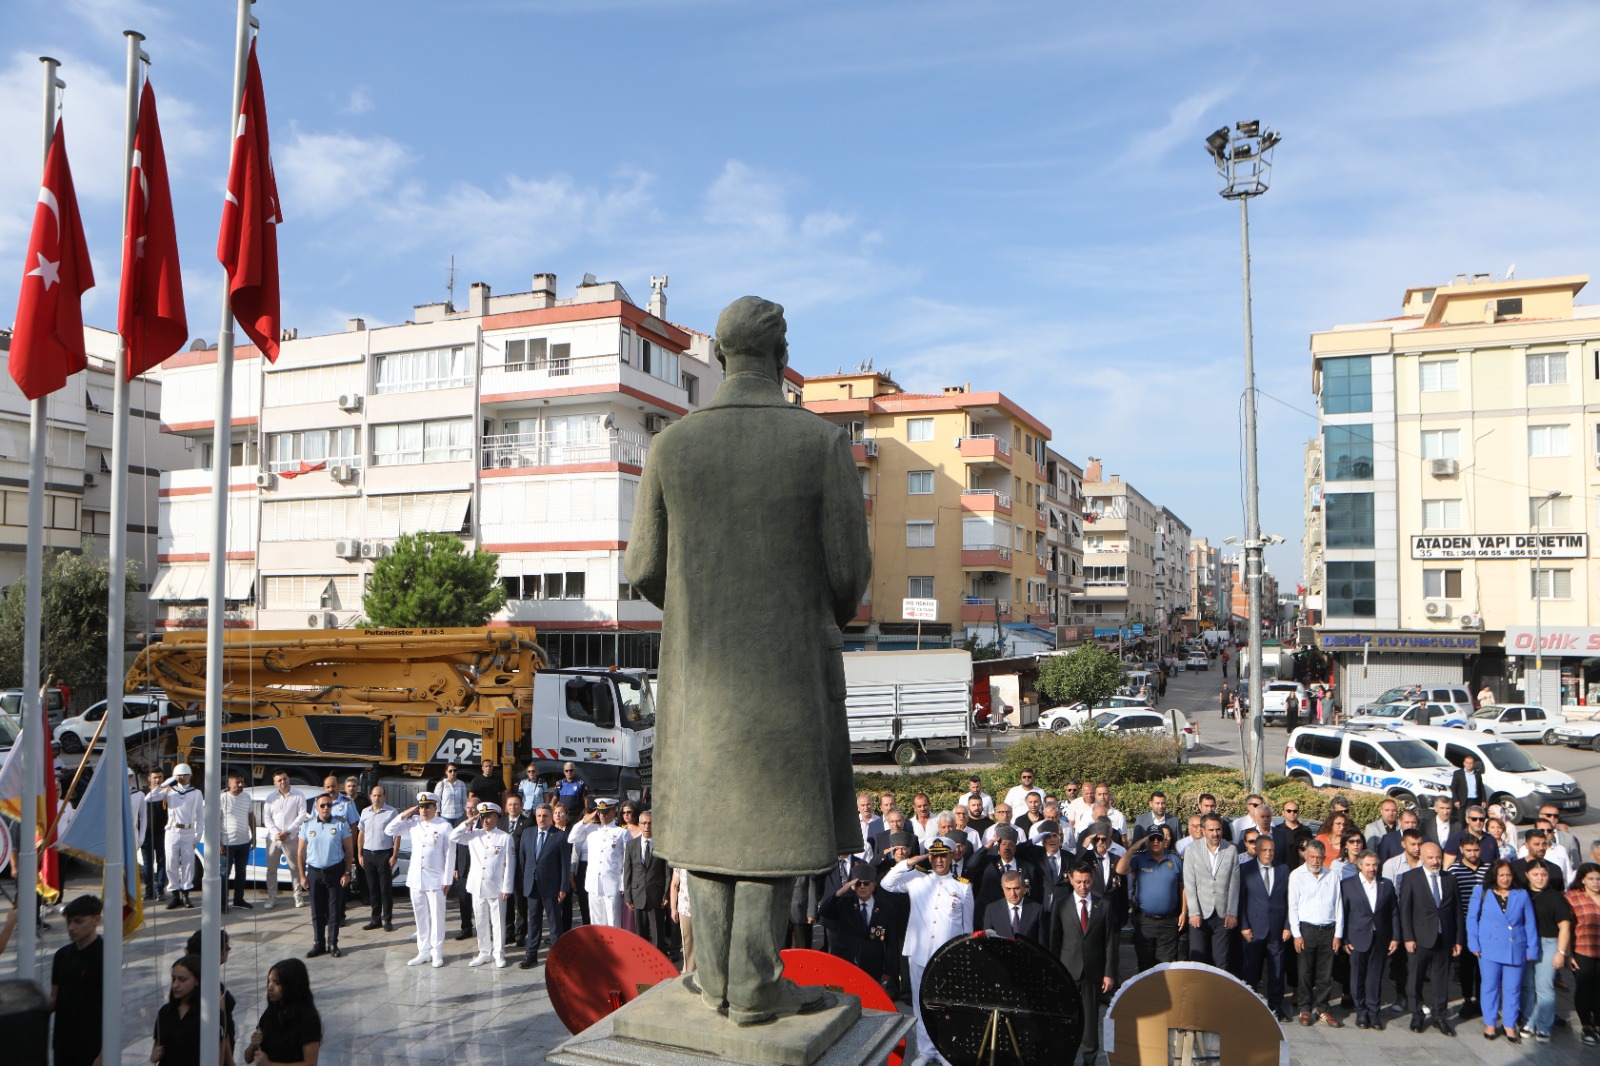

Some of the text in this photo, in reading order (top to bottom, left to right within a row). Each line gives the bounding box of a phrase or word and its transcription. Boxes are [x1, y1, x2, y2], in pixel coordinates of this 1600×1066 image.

[1416, 537, 1471, 549] ATADEN
[1478, 537, 1510, 549] YAPI
[1323, 634, 1478, 648] DENİZ KUYUMCULUK
[1515, 632, 1580, 653] Optik
[570, 736, 585, 744] KENT
